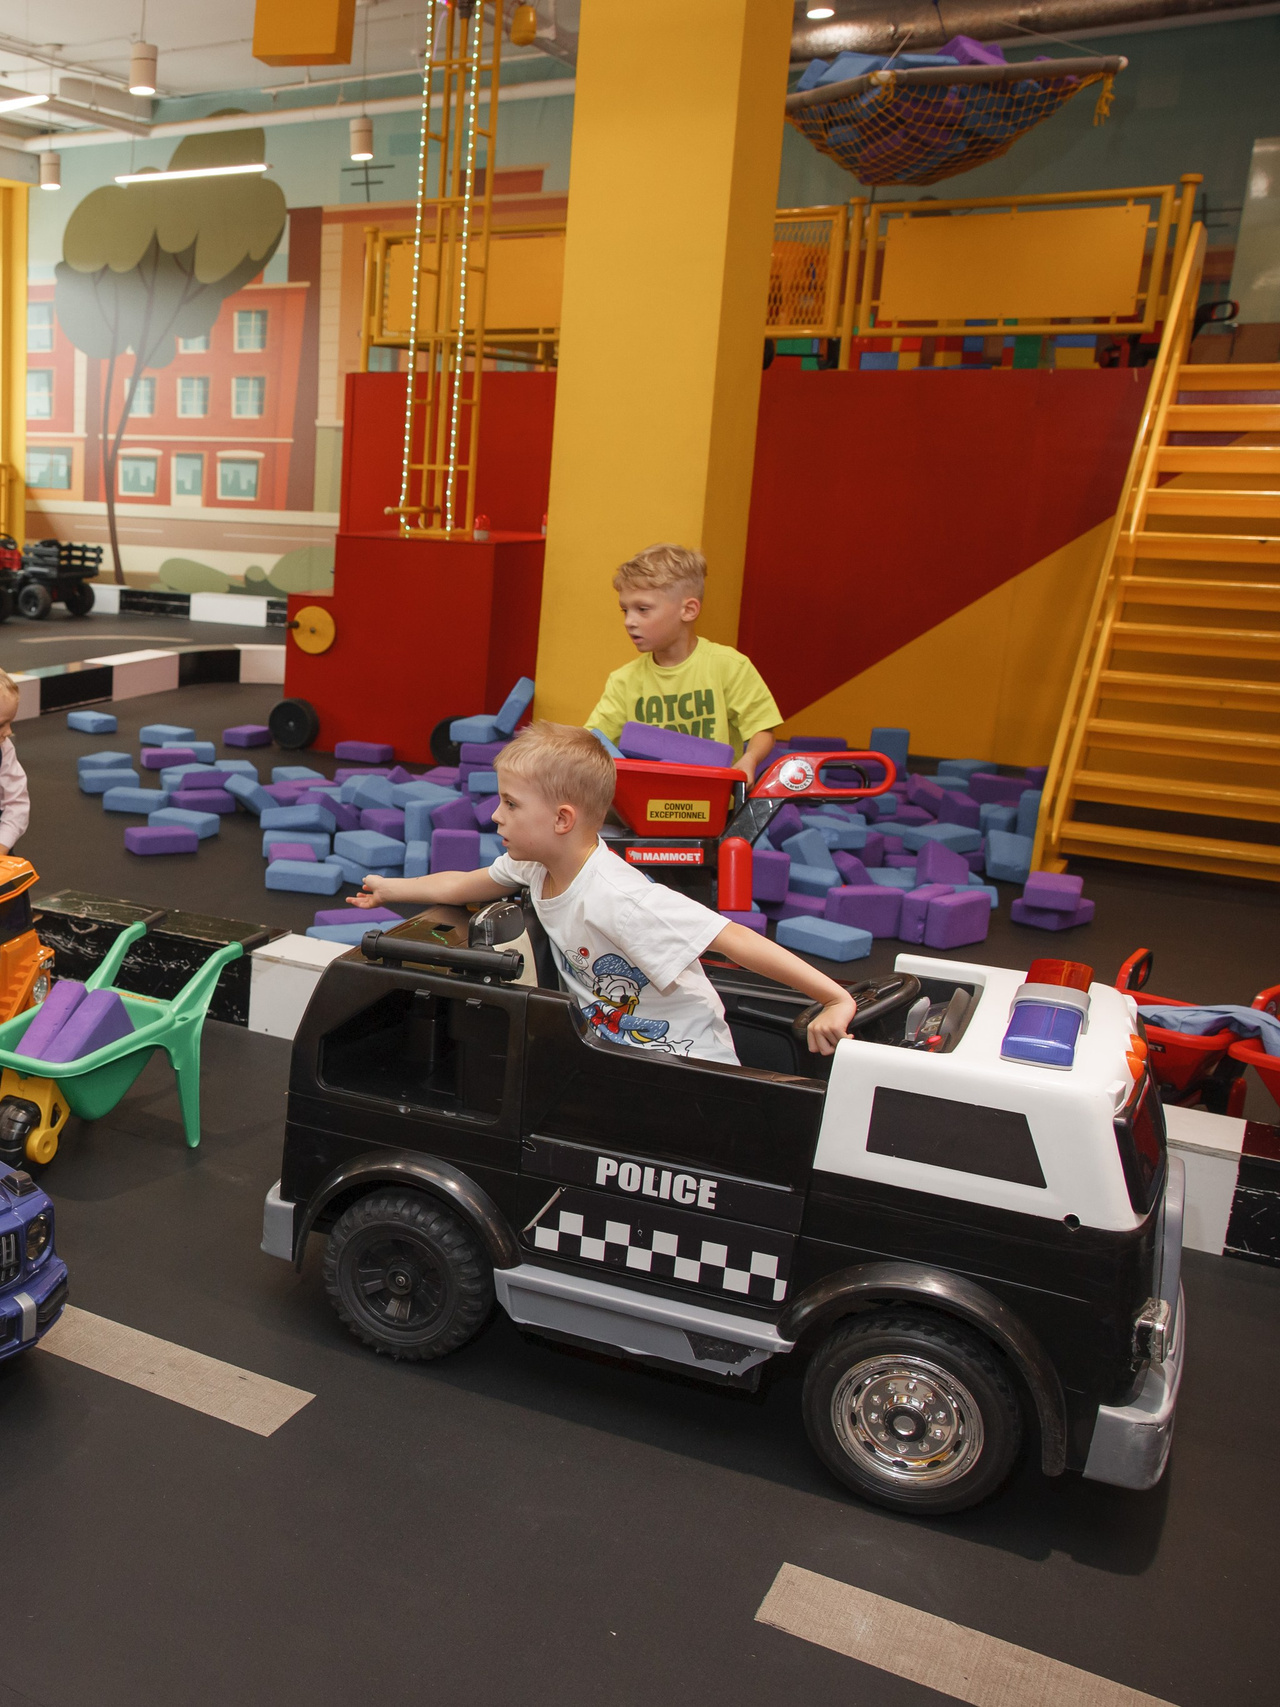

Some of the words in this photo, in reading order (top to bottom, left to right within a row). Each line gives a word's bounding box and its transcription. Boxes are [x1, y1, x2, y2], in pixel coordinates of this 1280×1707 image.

[664, 803, 694, 811] CONVOI
[649, 811, 707, 820] EXCEPTIONNEL
[642, 852, 702, 862] MAMMOET
[595, 1156, 718, 1210] POLICE
